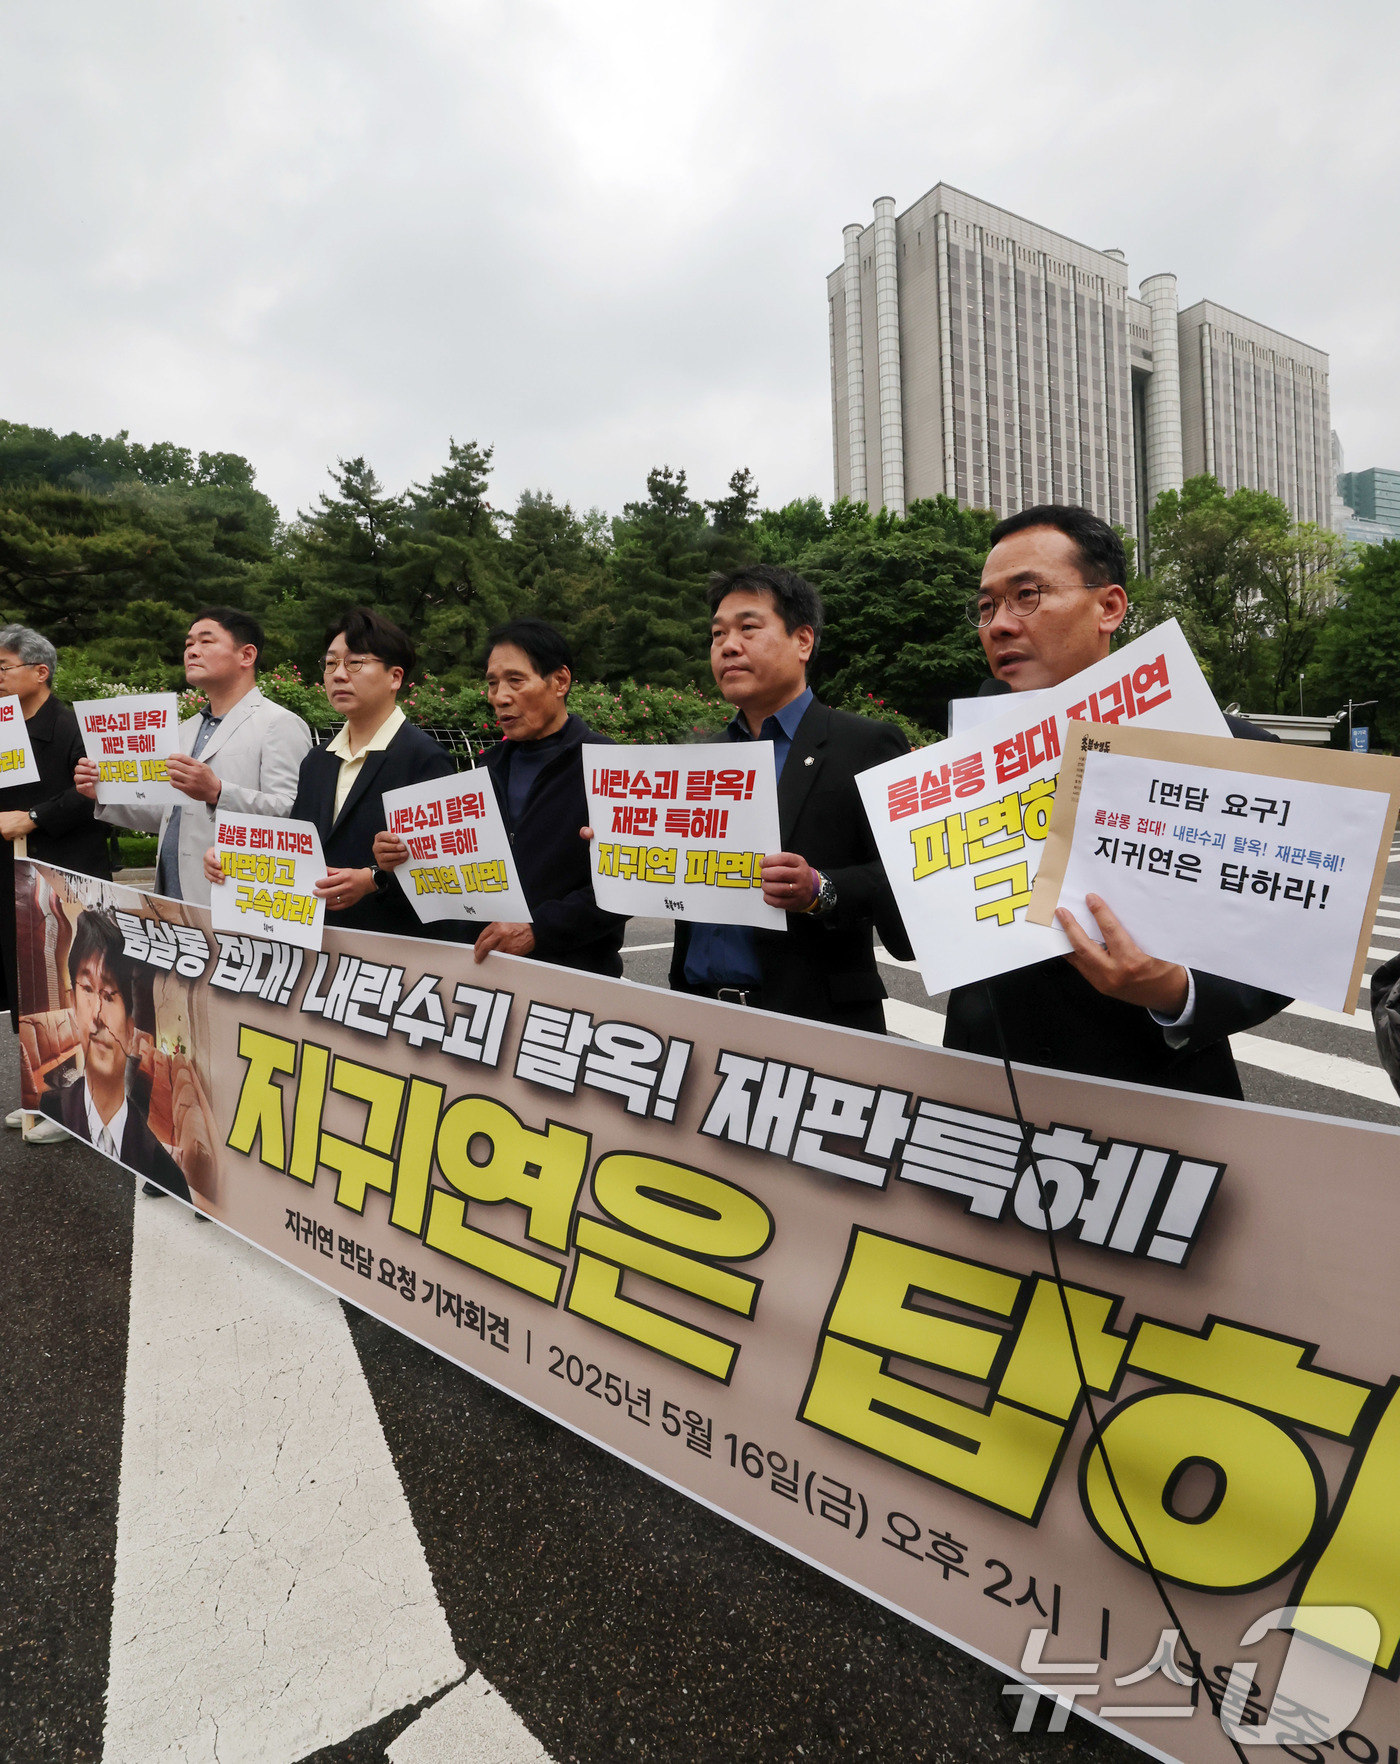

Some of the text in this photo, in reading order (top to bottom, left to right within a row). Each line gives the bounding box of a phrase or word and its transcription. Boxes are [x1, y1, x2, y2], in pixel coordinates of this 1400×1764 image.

[0, 705, 14, 722] 연
[84, 710, 167, 733] 내란수괴 탈옥!
[101, 734, 155, 754] 재판 특혜!
[98, 760, 139, 782] 지귀연
[592, 768, 756, 801] 내란수괴 탈옥!
[887, 751, 986, 822] 룸살롱
[993, 714, 1061, 785] 접대
[389, 792, 486, 834] 내란수괴 탈옥!
[611, 806, 729, 839] 재판 특혜!
[1148, 778, 1291, 827] [면담 요구]
[218, 823, 313, 855] 룸살롱 접대 지귀연
[407, 828, 478, 860] 재판 특혜!
[1094, 809, 1345, 873] 룸살롱 접대! 내란수괴 탈옥! 재판특혜!
[220, 851, 296, 887] 파면하고
[409, 860, 509, 895] 지귀연 파면!
[598, 842, 765, 888] 지귀연 파면!
[1094, 836, 1330, 910] 지귀연은 답하라!
[235, 885, 318, 925] 구속하라!
[973, 860, 1038, 927] 구
[115, 909, 1227, 1269] 룸살롱 접대! 내란수괴 탈옥! 재판특혜!
[226, 1022, 776, 1387] 지귀연은
[285, 1208, 334, 1259] 지귀연
[338, 1235, 374, 1280] 면담
[377, 1257, 416, 1302] 요청
[421, 1279, 510, 1353] 기자회견
[548, 1345, 651, 1427] 2025년
[661, 1400, 713, 1459] 5월
[724, 1433, 869, 1540] 16일(금)
[881, 1510, 971, 1580] 오후
[983, 1558, 1062, 1636] 2시
